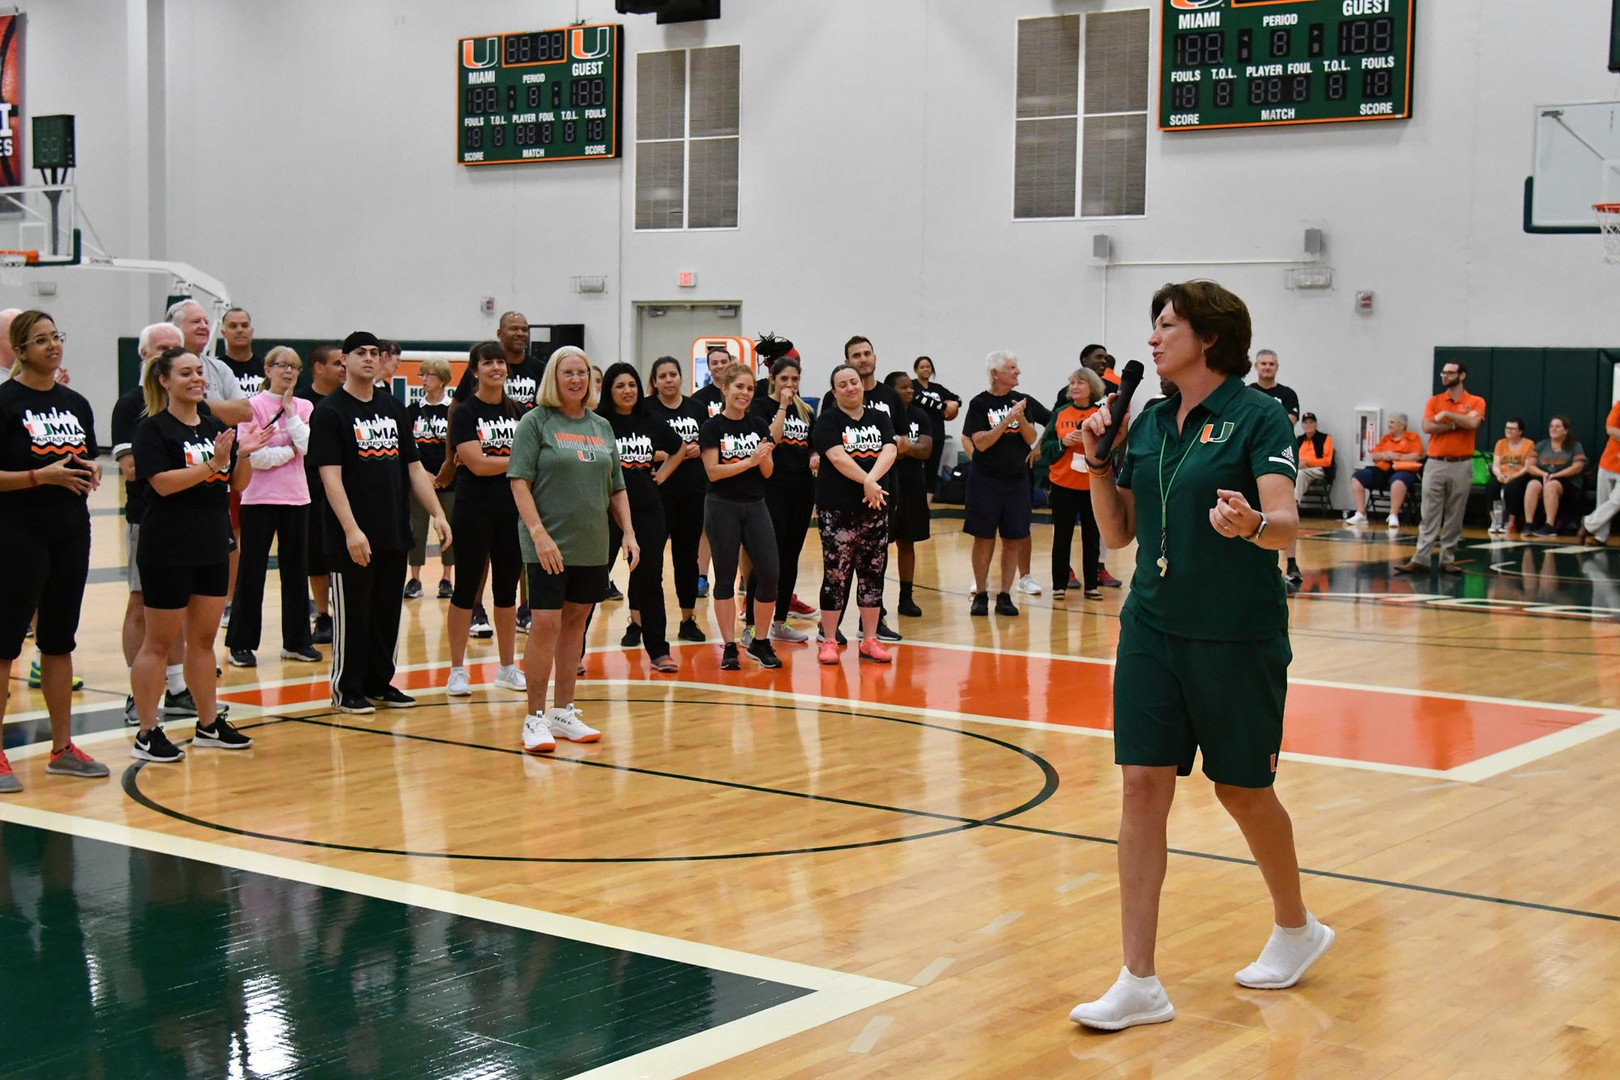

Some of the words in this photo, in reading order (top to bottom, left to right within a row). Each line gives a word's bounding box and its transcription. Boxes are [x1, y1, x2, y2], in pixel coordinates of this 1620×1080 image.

[1342, 0, 1390, 16] GUEST
[1178, 12, 1221, 29] MIAMI
[1263, 14, 1298, 27] PERIOD
[1323, 60, 1350, 72] T.O.L.
[1361, 56, 1395, 69] FOULS
[572, 62, 603, 76] GUEST
[1211, 68, 1237, 80] T.O.L.
[1246, 65, 1283, 77] PLAYER
[1287, 62, 1313, 74] FOUL
[468, 71, 496, 84] MIAMI
[522, 74, 545, 83] PERIOD
[1171, 70, 1201, 82] FOULS
[585, 109, 606, 119] FOULS
[1261, 108, 1295, 120] MATCH
[1360, 102, 1393, 115] SCORE
[465, 117, 484, 126] FOULS
[490, 116, 507, 125] T.O.L.
[512, 113, 536, 123] PLAYER
[539, 112, 555, 122] FOUL
[561, 111, 578, 120] T.O.L.
[1169, 114, 1199, 126] SCORE
[522, 148, 544, 158] MATCH
[585, 145, 606, 154] SCORE
[464, 152, 484, 161] SCORE
[1200, 421, 1234, 443] U
